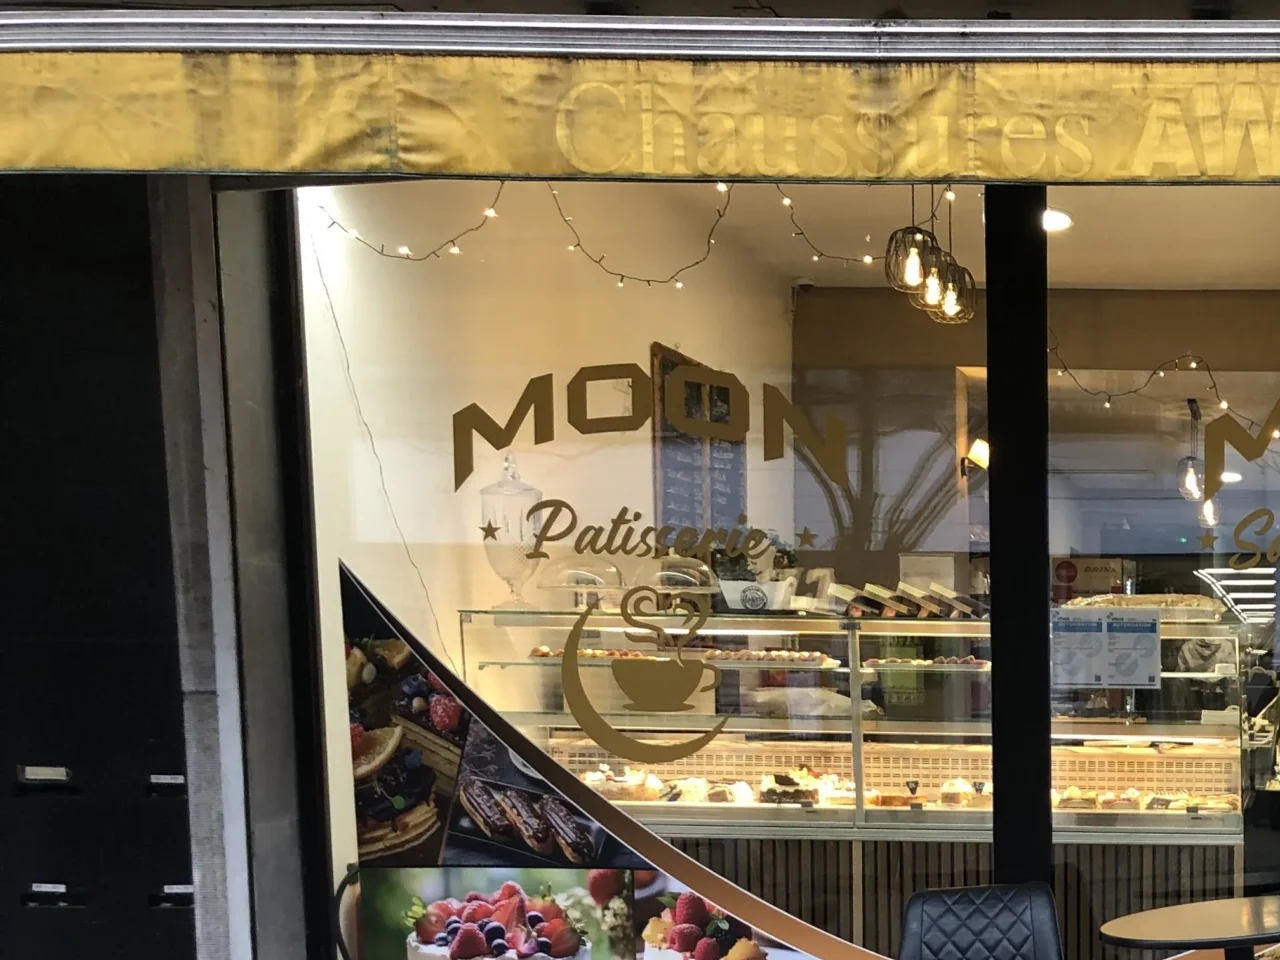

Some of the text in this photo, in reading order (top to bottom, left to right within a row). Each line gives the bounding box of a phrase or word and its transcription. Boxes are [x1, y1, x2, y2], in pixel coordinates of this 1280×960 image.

[555, 80, 1096, 178] Chaussures
[452, 363, 849, 492] MOON
[525, 498, 772, 560] Patisserie
